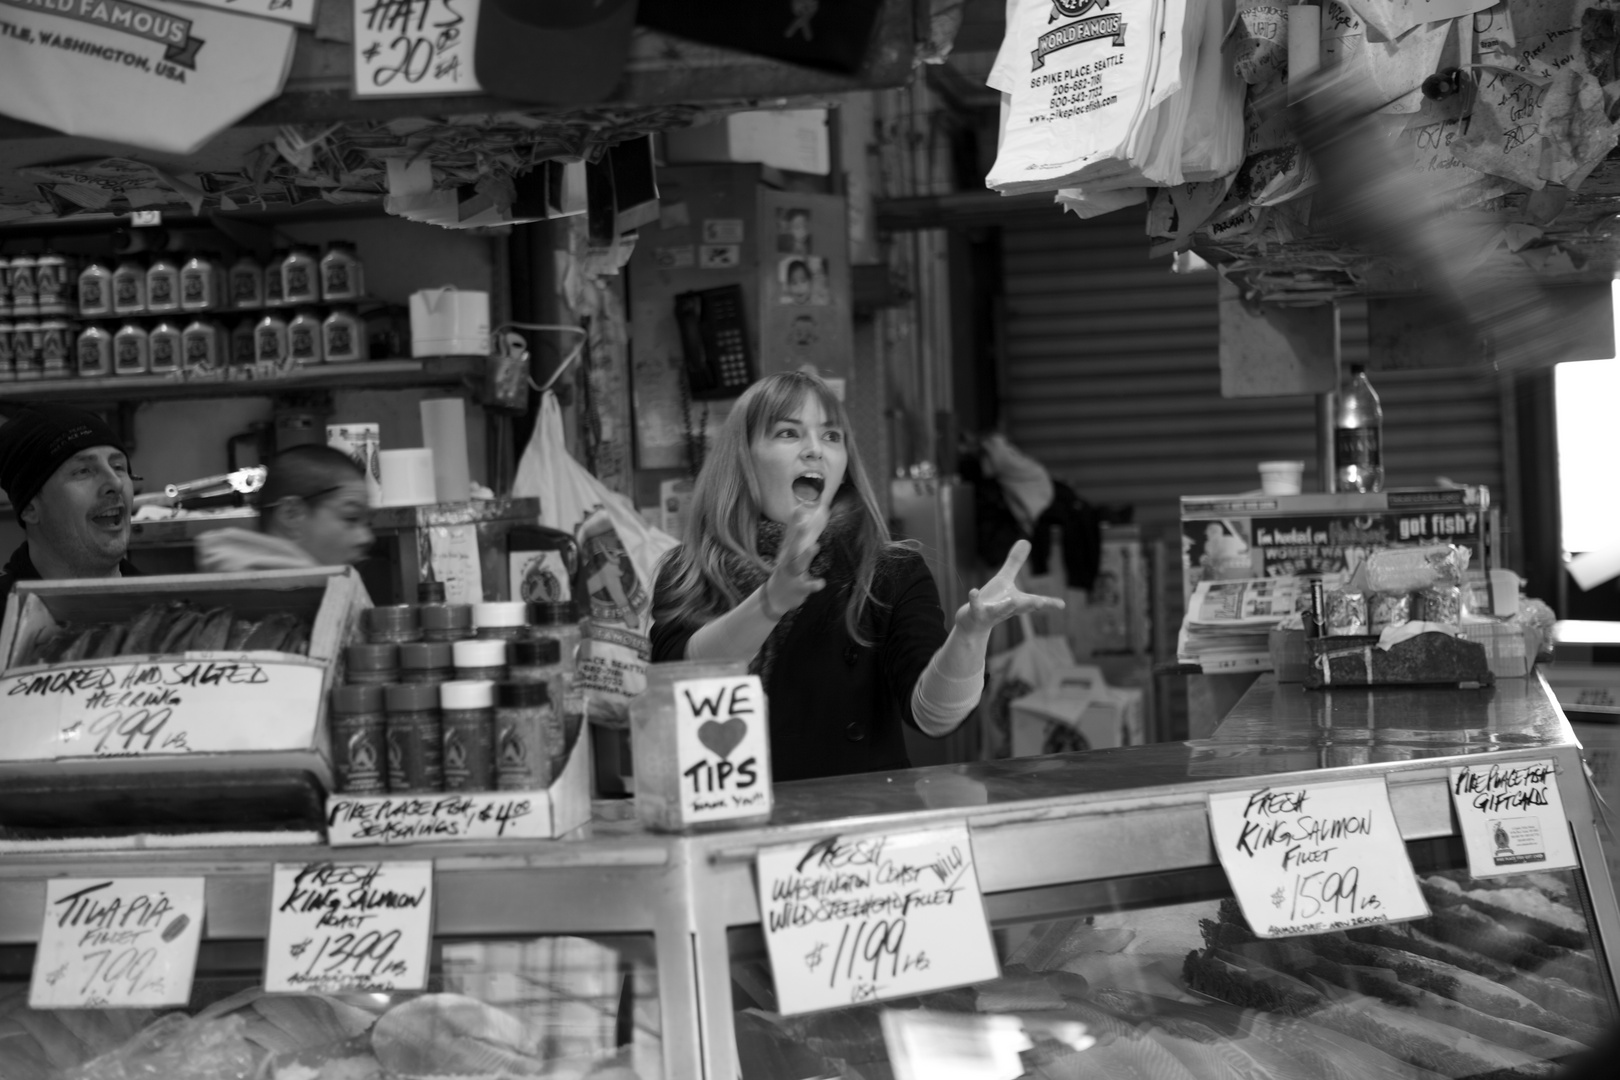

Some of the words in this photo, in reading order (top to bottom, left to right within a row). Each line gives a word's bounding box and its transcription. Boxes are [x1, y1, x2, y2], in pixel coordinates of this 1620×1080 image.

[80, 0, 186, 43] FAMOUS
[1040, 27, 1076, 53] WORLD
[1078, 17, 1119, 41] FAMOUS
[38, 31, 151, 72] WASHINGTON,
[154, 62, 187, 84] USA
[1030, 78, 1041, 89] 86
[1043, 71, 1062, 85] PIKE
[1064, 65, 1093, 81] PLACE,
[1094, 53, 1124, 73] SEATTLE
[1400, 514, 1427, 540] got
[1432, 512, 1477, 534] fish?
[1265, 546, 1318, 560] WOMEN
[8, 666, 116, 696] SMOKED
[120, 663, 164, 690] AND
[163, 662, 269, 688] SALTED
[684, 684, 755, 718] WE
[684, 757, 757, 793] TIPS
[1455, 766, 1487, 795] PIKE
[1487, 764, 1522, 793] PLACE
[1521, 763, 1556, 787] FISH
[328, 799, 378, 827] PIKE
[375, 799, 431, 820] PLACE
[1243, 787, 1310, 818] FRESH
[1236, 819, 1292, 858] KING
[1291, 809, 1372, 846] SALMON
[796, 834, 891, 873] FRESH
[1281, 844, 1338, 871] FILLET
[294, 862, 385, 888] FRESH
[771, 871, 870, 901] WASHINGTON
[53, 880, 175, 928] TILAPIA
[279, 886, 342, 913] KING
[342, 887, 426, 913] SALMON
[769, 902, 815, 933] WILD
[78, 926, 152, 948] FILLET
